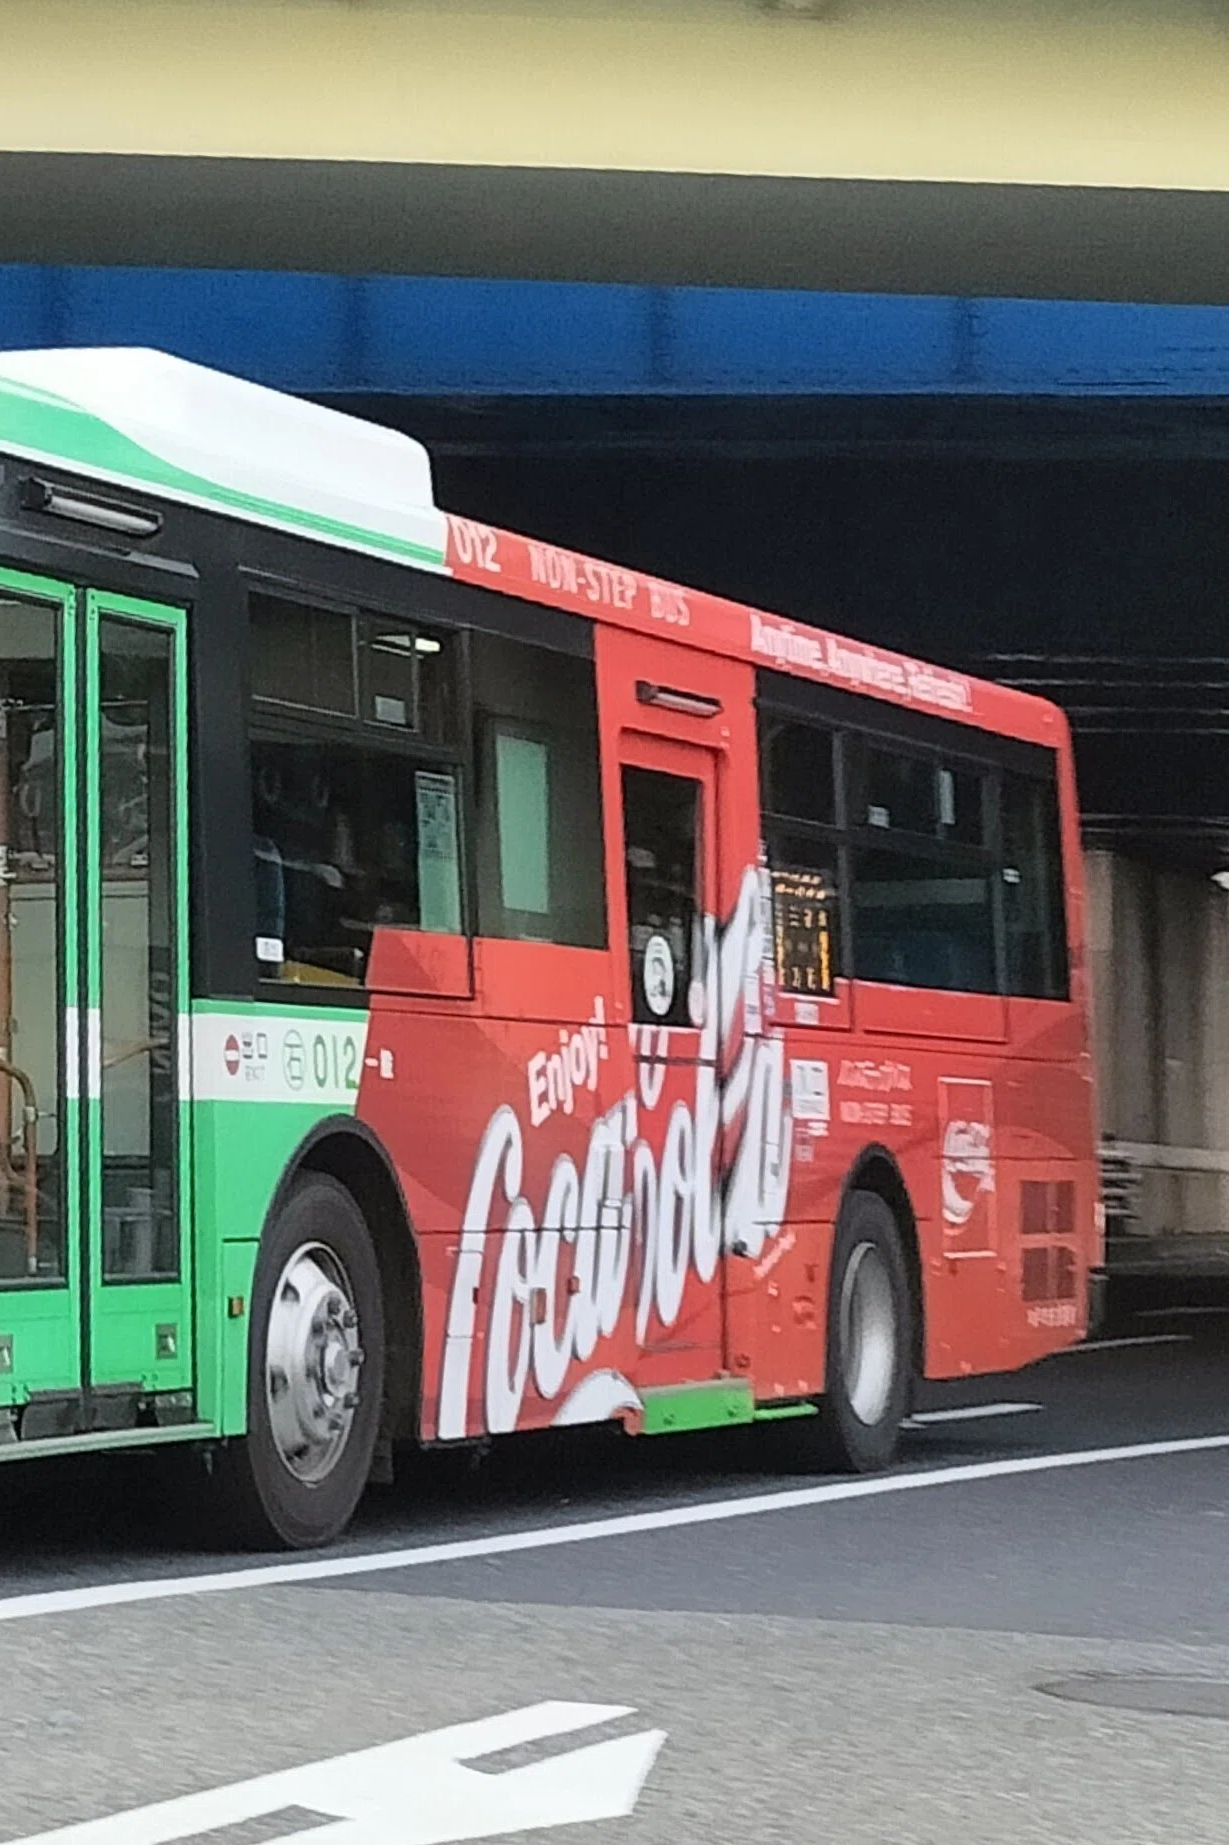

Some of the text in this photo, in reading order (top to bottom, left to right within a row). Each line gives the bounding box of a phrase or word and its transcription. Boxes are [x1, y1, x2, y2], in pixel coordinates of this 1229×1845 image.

[449, 517, 690, 627] 012 NON-STEP BUS
[313, 1033, 359, 1090] 012
[527, 995, 609, 1128] Enjoy!
